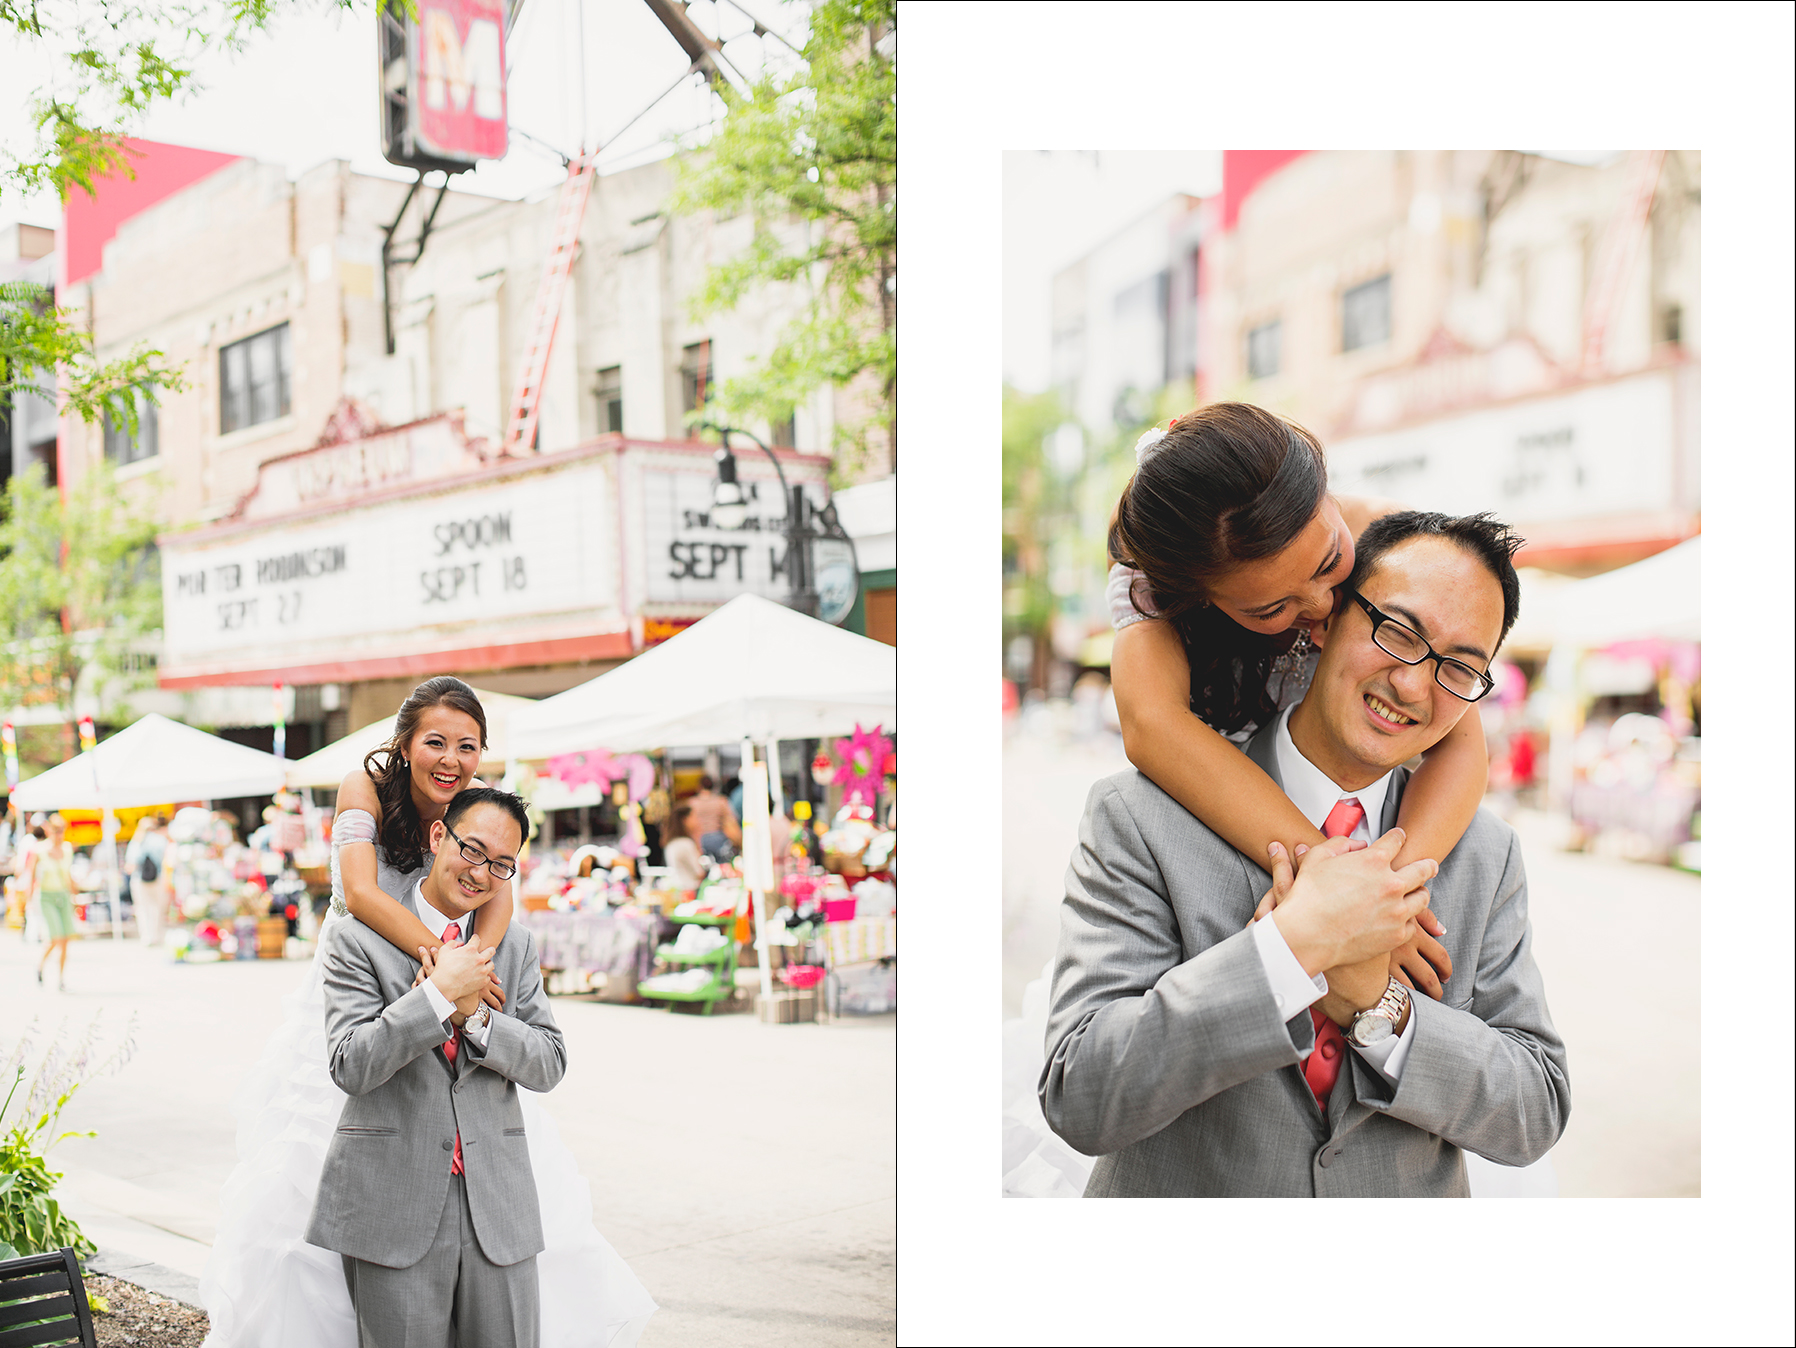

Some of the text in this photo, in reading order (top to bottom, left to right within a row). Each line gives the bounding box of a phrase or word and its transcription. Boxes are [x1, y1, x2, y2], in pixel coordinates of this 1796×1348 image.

[424, 7, 503, 121] M
[433, 509, 513, 557] SPOON
[420, 555, 527, 605] SEPT 18
[669, 540, 748, 582] SEPT
